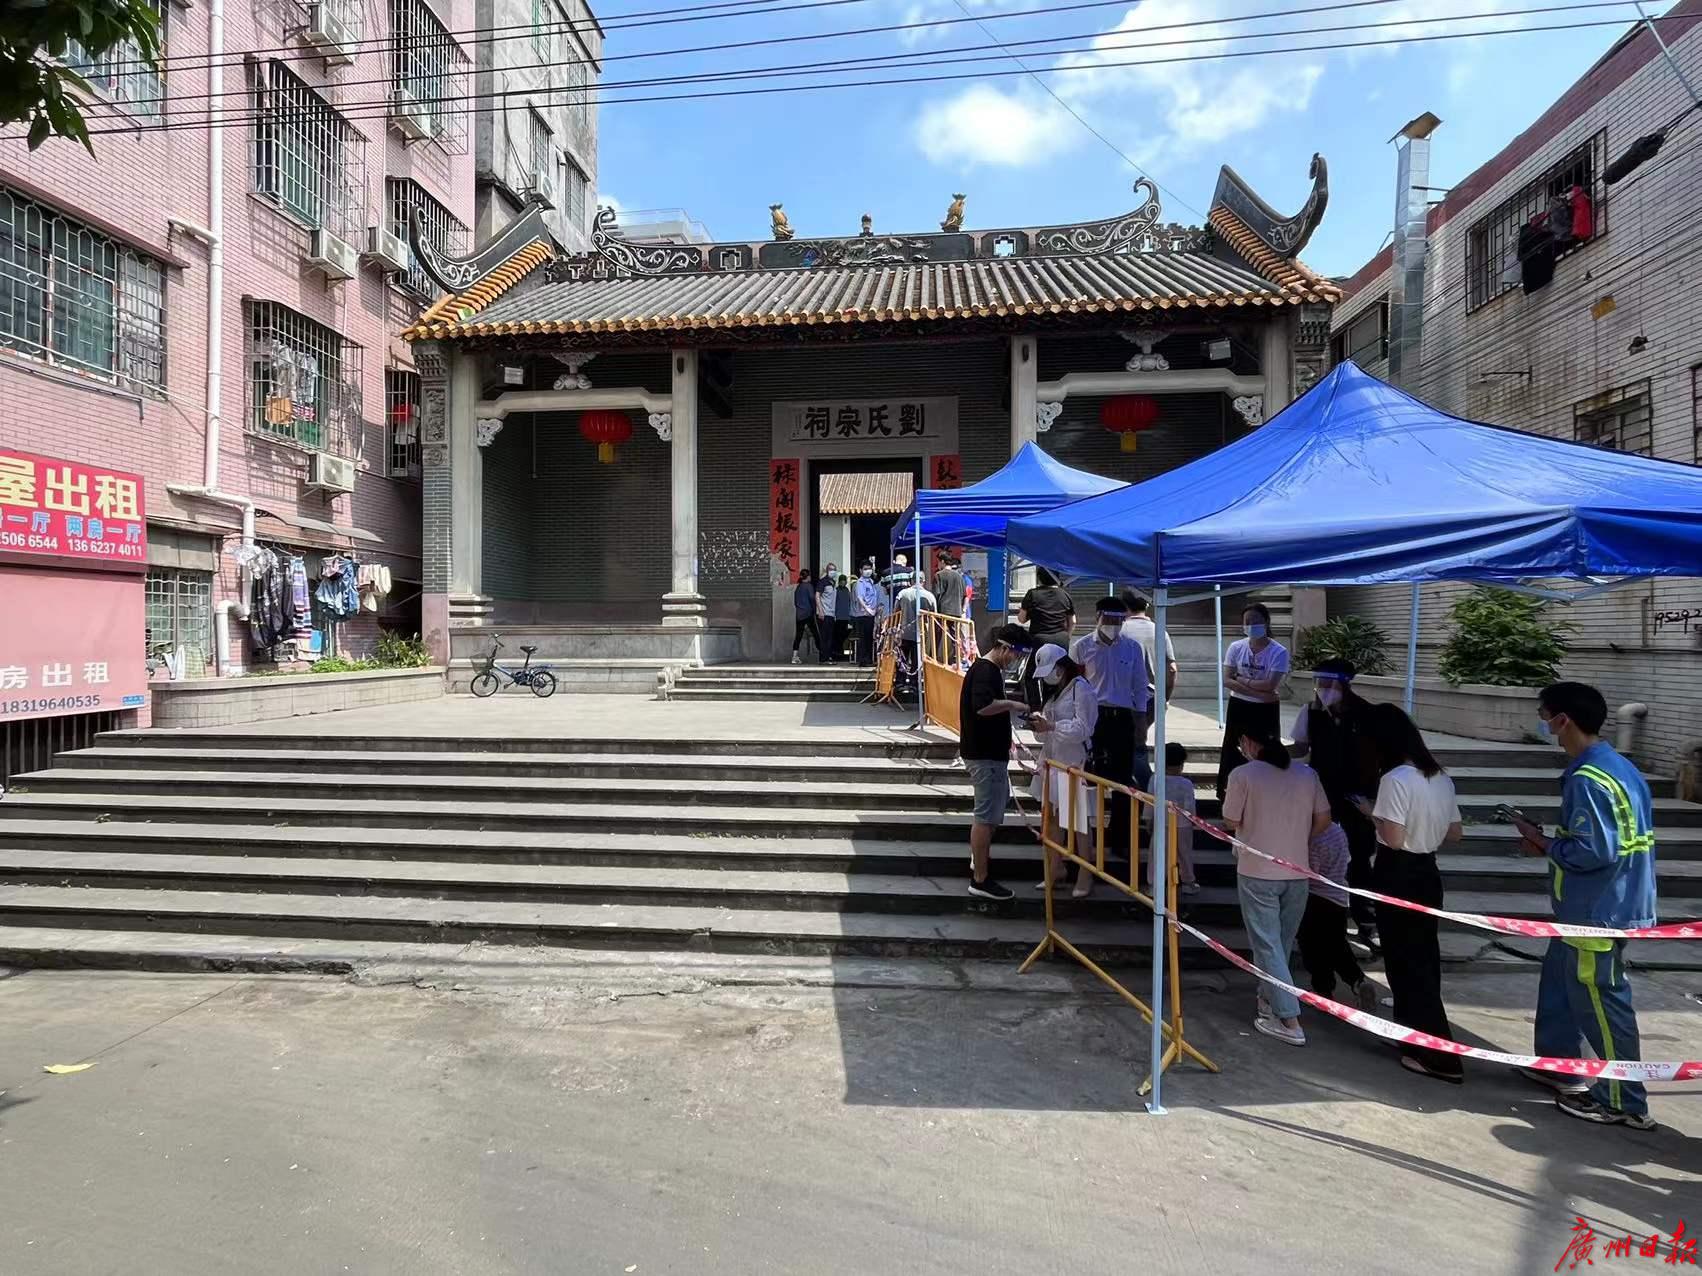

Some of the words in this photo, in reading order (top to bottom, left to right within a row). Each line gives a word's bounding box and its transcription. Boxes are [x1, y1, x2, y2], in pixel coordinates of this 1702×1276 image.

[804, 404, 926, 438] 劉氏宗祠
[0, 456, 142, 521] 屋出租
[0, 507, 51, 534] 一厅
[65, 515, 141, 544] 两房一厅
[0, 531, 26, 547] 506
[28, 534, 58, 550] 6544
[68, 538, 88, 552] 136
[90, 540, 116, 555] 6237
[118, 543, 142, 557] 4011
[0, 662, 110, 689] 房出租
[1, 694, 101, 714] 18319640535
